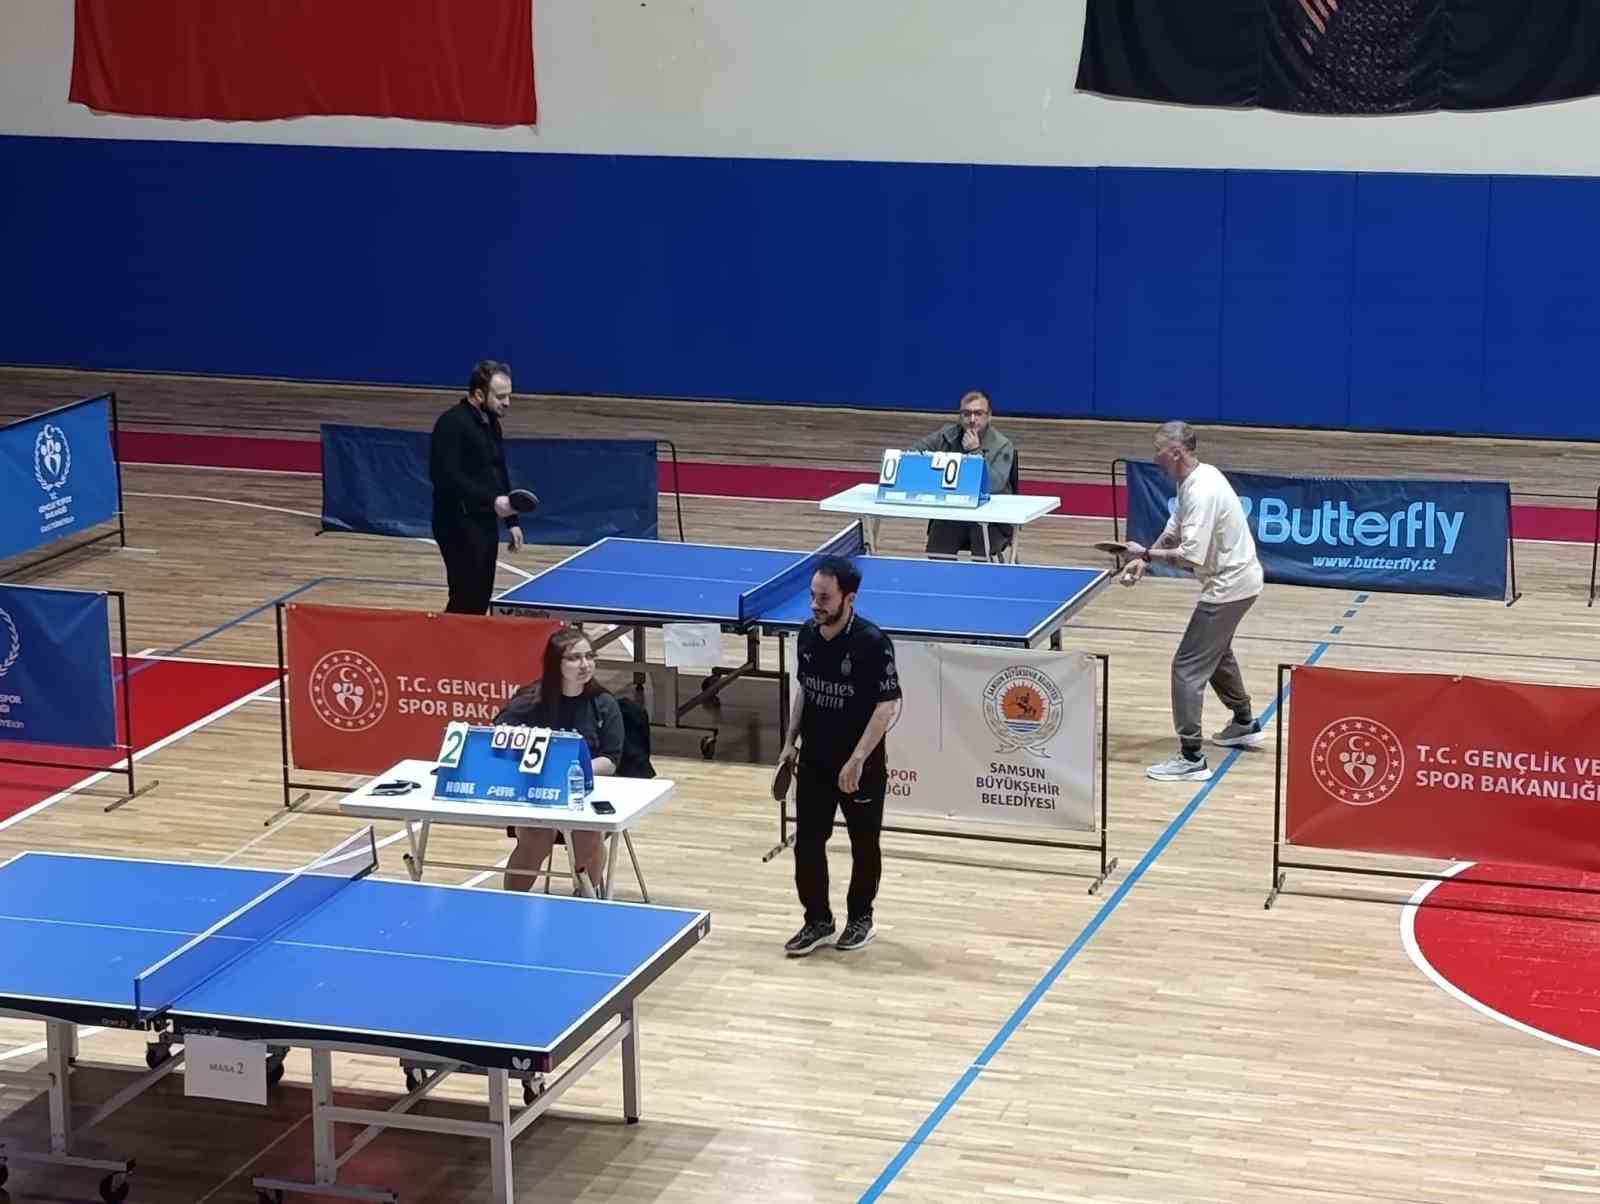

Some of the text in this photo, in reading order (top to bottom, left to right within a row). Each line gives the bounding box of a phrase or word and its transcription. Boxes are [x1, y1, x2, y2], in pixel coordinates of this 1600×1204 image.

[944, 459, 958, 484] 0
[1257, 497, 1465, 554] Butterfly
[1312, 556, 1437, 572] www.butterfly.tt
[397, 676, 432, 694] T.C.
[800, 673, 855, 697] mirates
[398, 699, 448, 716] SPOR
[440, 730, 463, 764] 2
[523, 736, 547, 769] 5
[989, 762, 1046, 780] SAMSUN
[1416, 745, 1600, 777] T.C. GENÇLİK VE
[445, 781, 475, 795] HOME
[975, 775, 1060, 797] BÜYÜKŞEHİR
[1416, 770, 1474, 791] SPOR
[527, 787, 561, 801] GUEST
[981, 790, 1056, 810] BELEDİYESİ
